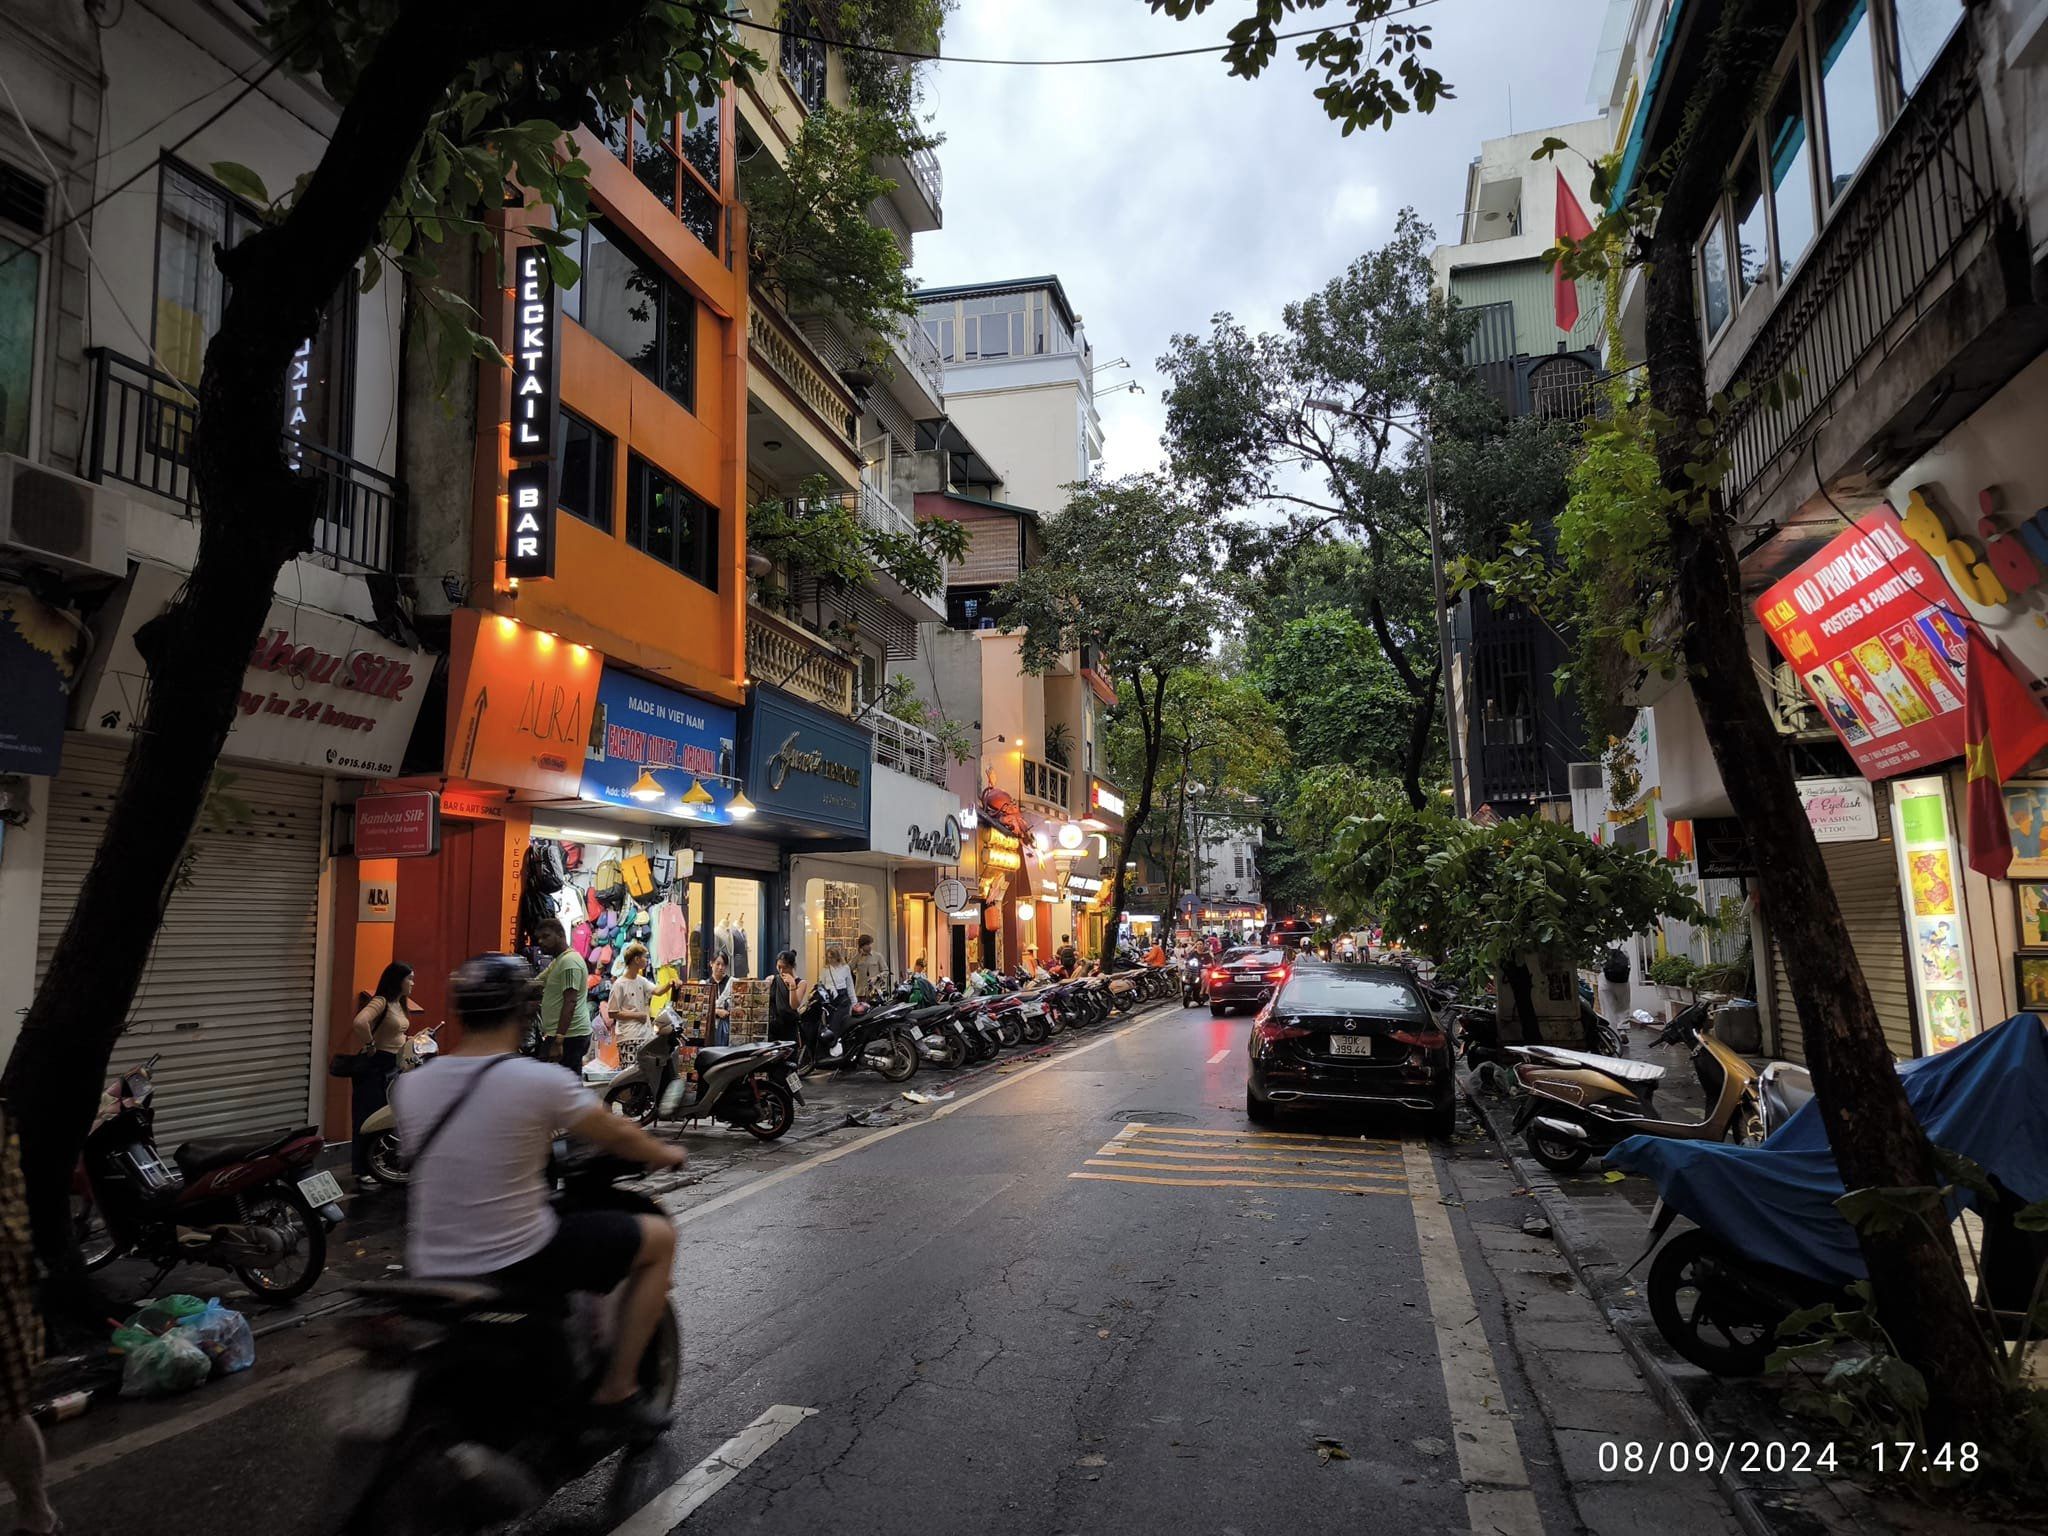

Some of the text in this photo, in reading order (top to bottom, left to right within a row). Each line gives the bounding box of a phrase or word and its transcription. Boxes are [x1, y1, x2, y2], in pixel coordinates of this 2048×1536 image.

[516, 488, 539, 557] BAR
[1793, 521, 1910, 616] OLD PROPAGANDA
[1819, 566, 1924, 638] POSTERS & PAINTING
[343, 651, 413, 701] Silk
[264, 692, 290, 716] in
[288, 698, 323, 721] 24
[319, 705, 376, 732] hours
[517, 679, 581, 746] AURA
[628, 696, 705, 730] MADE IN VIET NAM
[607, 723, 647, 763] FACTORY
[647, 733, 678, 764] OUTLET
[443, 800, 458, 810] BAR
[466, 803, 480, 813] ART
[481, 806, 502, 816] SPACE
[605, 786, 620, 797] Add:
[1821, 796, 1862, 815] Eyelash
[360, 809, 425, 825] Bambou Silk
[403, 825, 418, 833] hours
[1819, 815, 1862, 823] WASHING
[512, 837, 521, 901] VEGGIE
